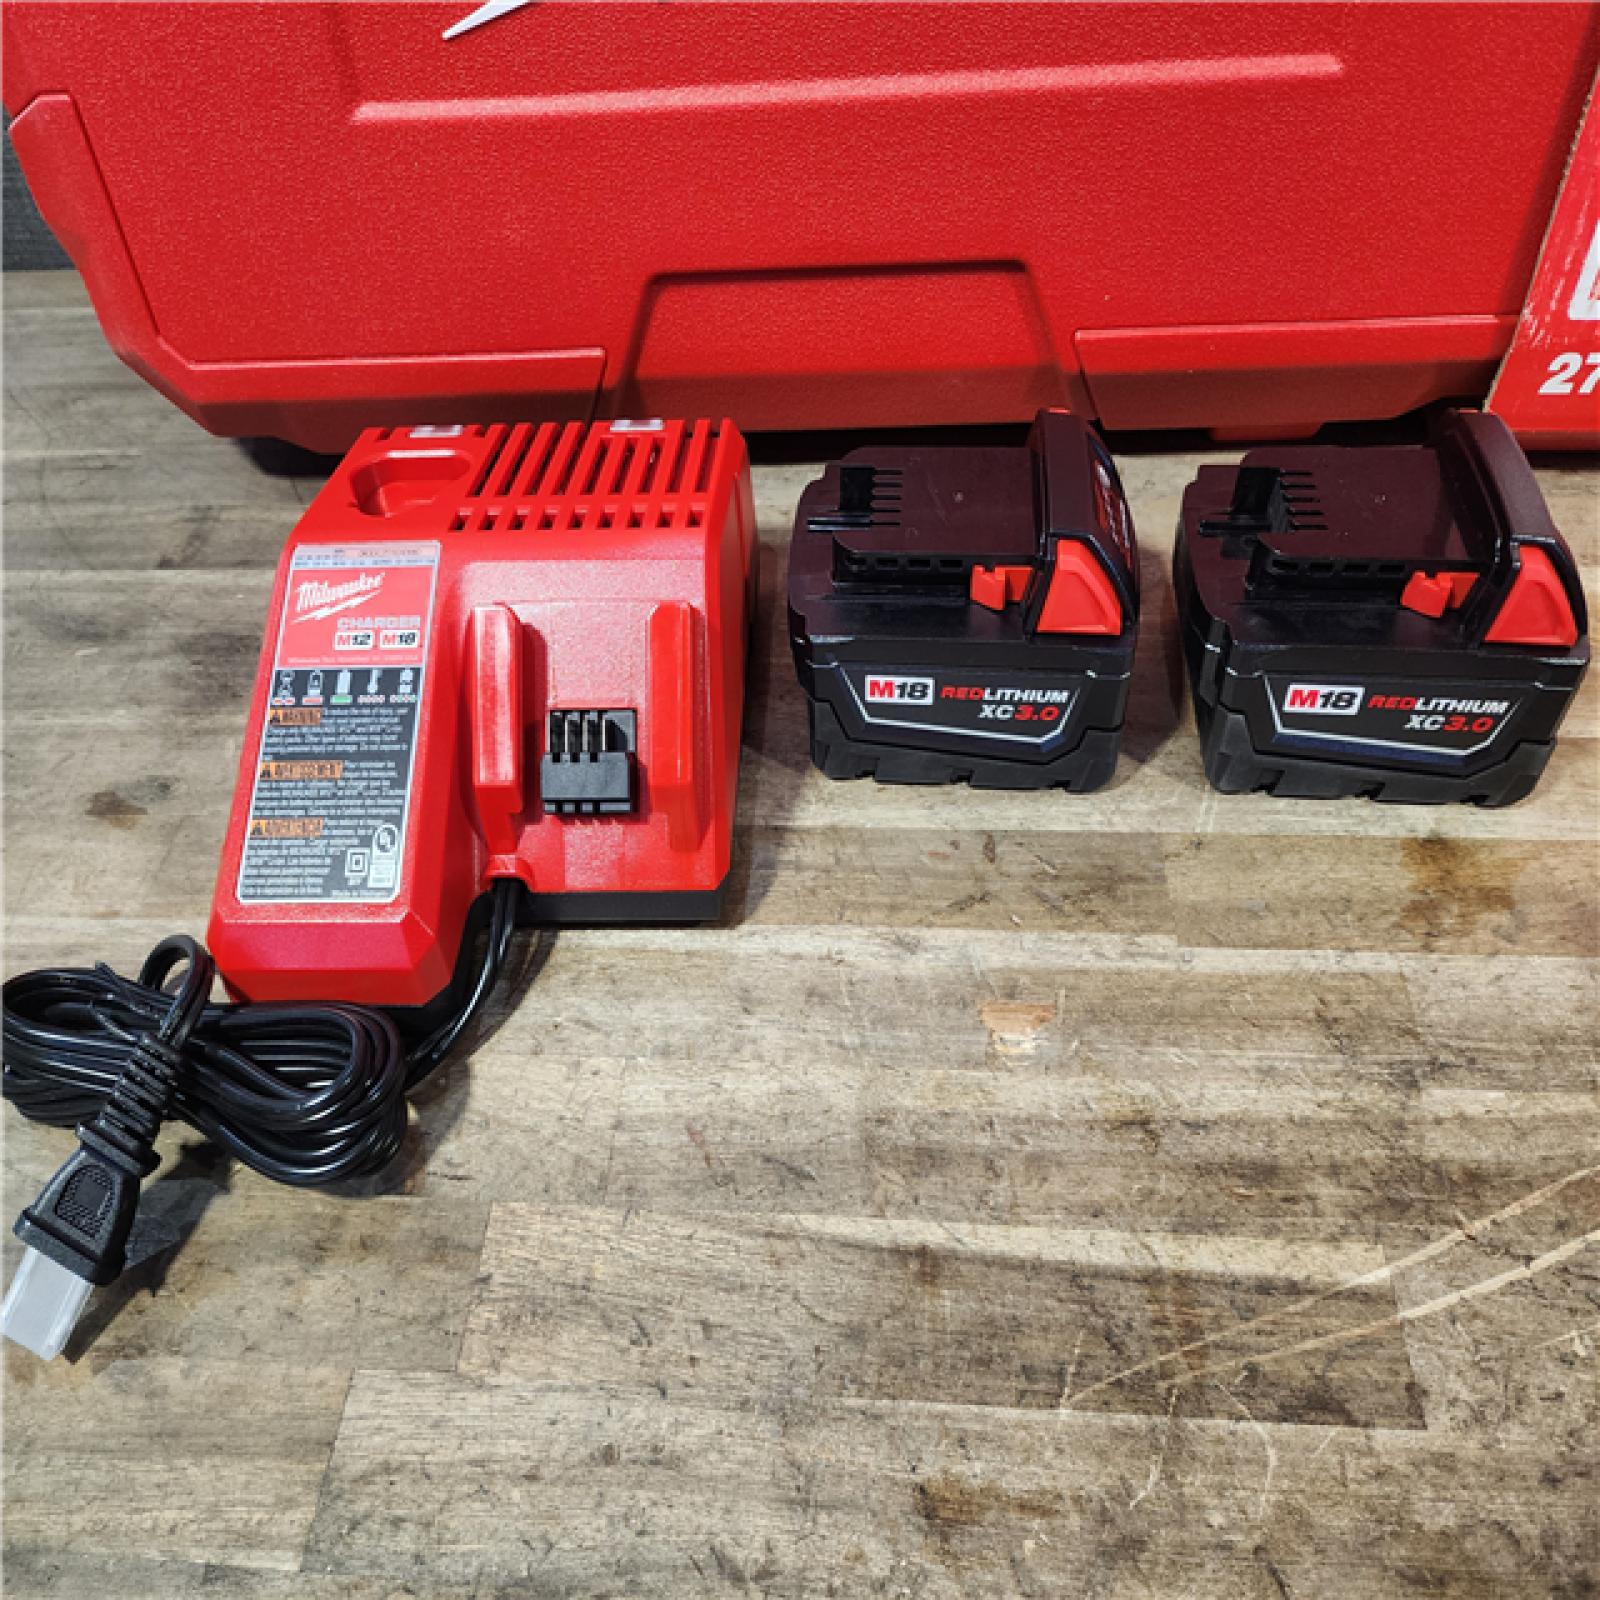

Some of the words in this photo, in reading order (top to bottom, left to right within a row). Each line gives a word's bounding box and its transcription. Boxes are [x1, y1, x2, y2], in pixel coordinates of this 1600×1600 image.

[295, 572, 385, 612] Milwaukee
[336, 616, 421, 630] CHARGER
[336, 633, 372, 647] M12
[382, 632, 417, 647] M18
[869, 679, 930, 700] M18
[940, 684, 1070, 704] REDLITHIUM
[1288, 688, 1358, 709] M18
[1367, 694, 1511, 714] REDLITHIUM
